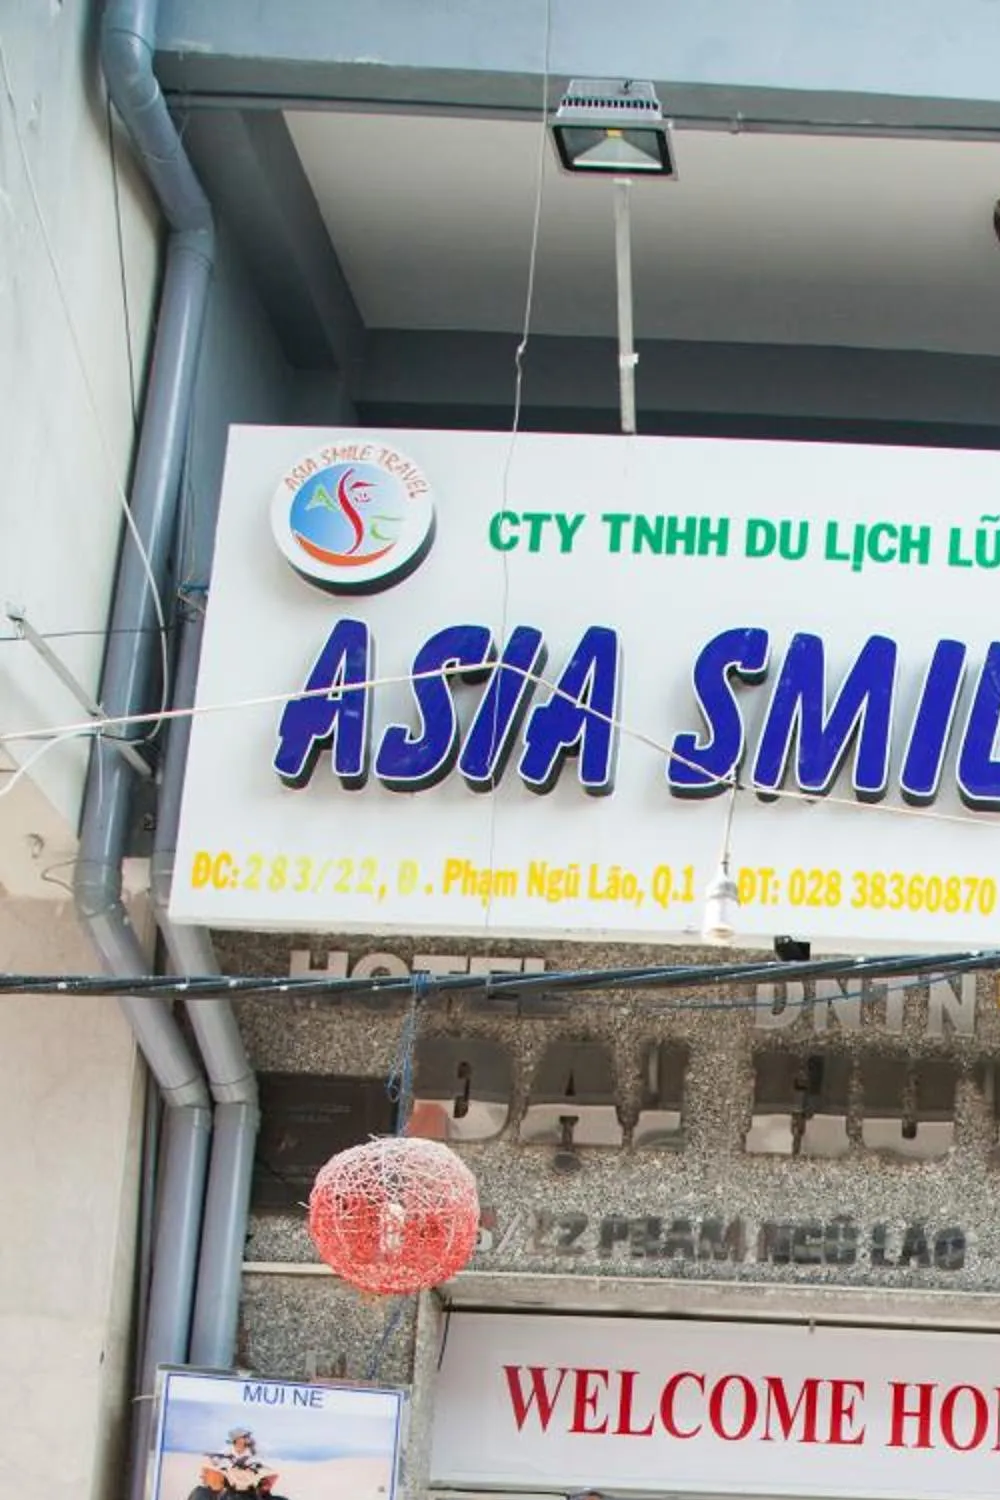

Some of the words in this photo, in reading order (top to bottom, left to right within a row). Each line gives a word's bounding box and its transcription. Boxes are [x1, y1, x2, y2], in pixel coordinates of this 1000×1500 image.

[284, 458, 317, 491] ASIA
[320, 444, 373, 465] SMILE
[377, 448, 429, 499] TRAVEL
[488, 511, 585, 554] CTY
[601, 513, 729, 557] TNHH
[745, 519, 810, 561] DU
[825, 521, 930, 573] LỊCH
[271, 618, 621, 798] ASIA
[442, 857, 518, 909] Phạm
[652, 864, 695, 909] Q.1
[788, 868, 842, 908] 028
[850, 870, 998, 917] 38360870
[753, 970, 977, 1038] DNTN
[243, 1383, 286, 1407] MUI
[293, 1388, 325, 1410] NE
[502, 1365, 866, 1446] WELCOME
